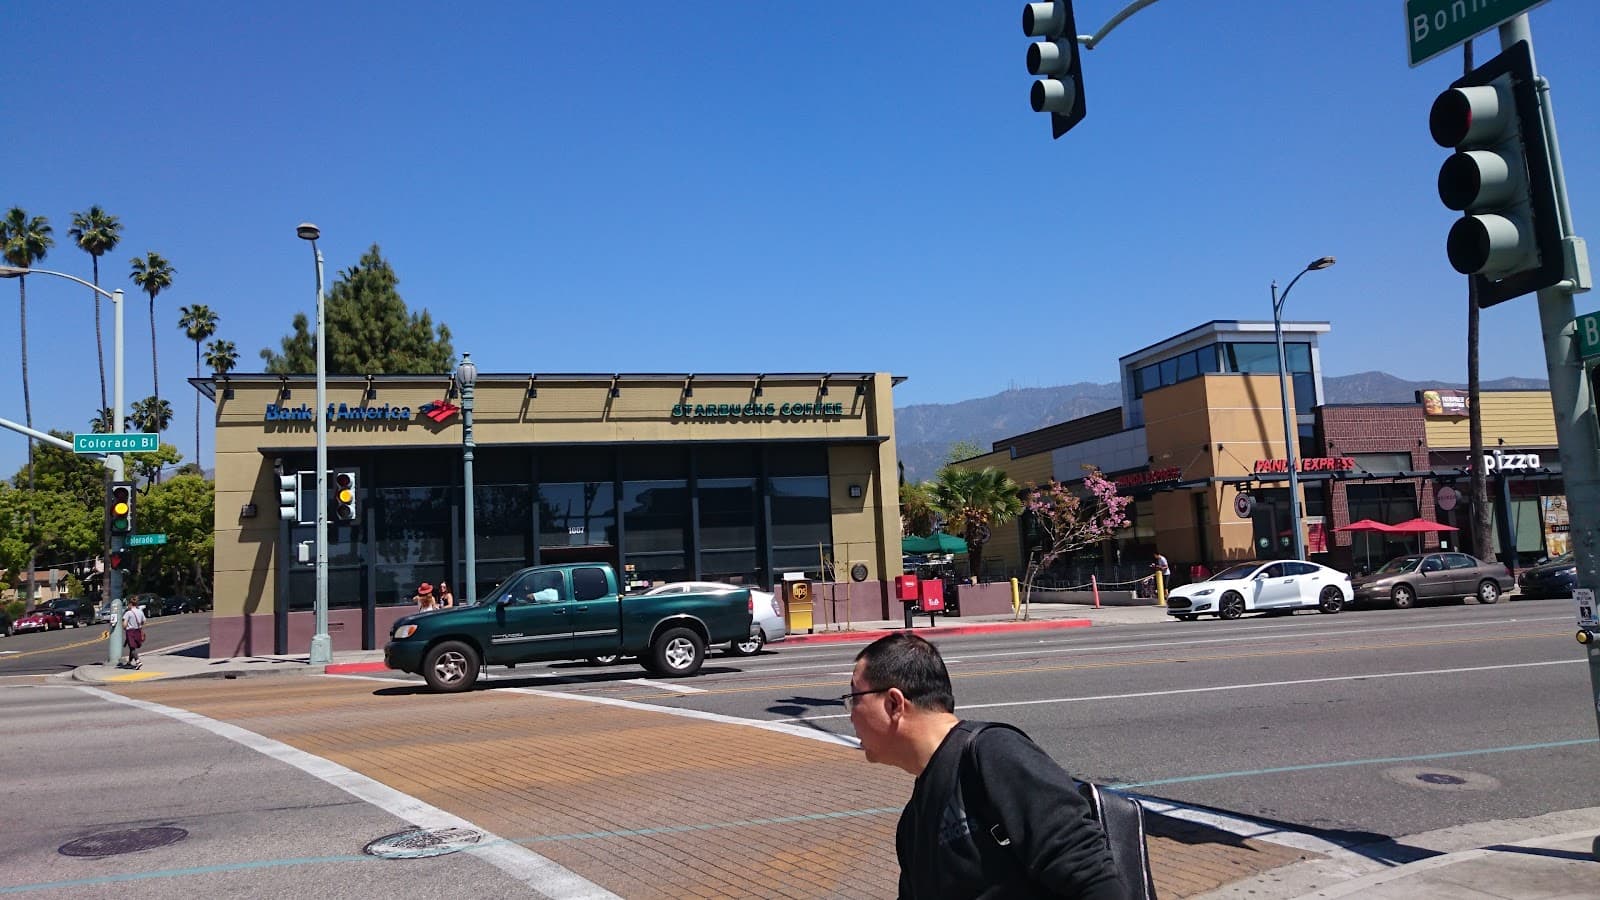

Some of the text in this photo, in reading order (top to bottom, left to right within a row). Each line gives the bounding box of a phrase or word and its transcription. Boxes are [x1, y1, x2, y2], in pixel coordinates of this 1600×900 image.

[1413, 0, 1499, 42] Bon
[266, 403, 312, 420] Bank
[337, 403, 411, 420] America
[672, 403, 843, 417] STARBUCKS COFFEE
[79, 438, 154, 448] Colorado Bl
[1303, 457, 1355, 471] EXPRESS
[1466, 450, 1540, 475] pizza
[794, 587, 808, 598] ups
